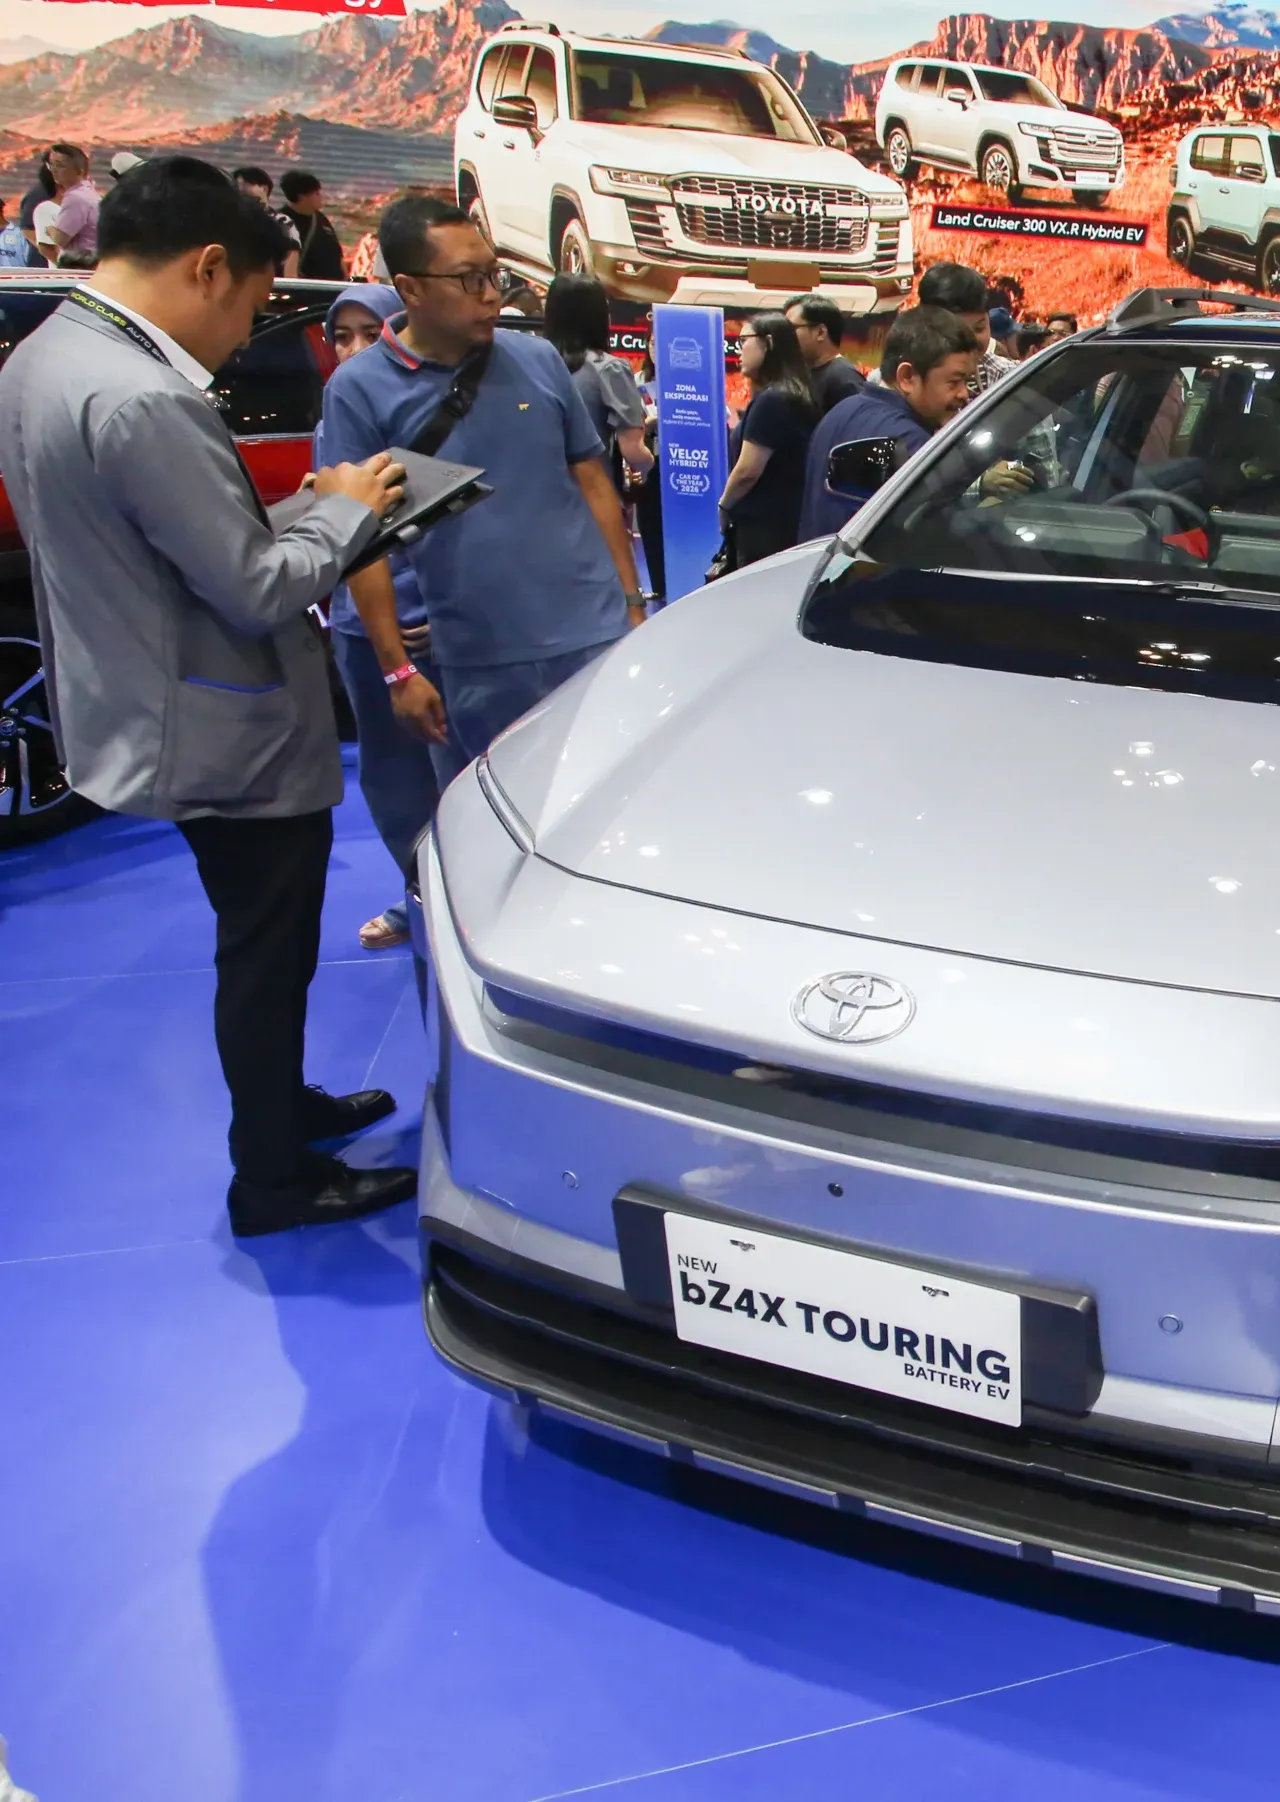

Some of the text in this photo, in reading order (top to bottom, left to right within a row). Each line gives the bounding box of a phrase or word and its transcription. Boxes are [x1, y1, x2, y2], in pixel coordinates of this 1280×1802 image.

[736, 194, 825, 217] TOYOTA
[937, 211, 1144, 241] Land Cruiser 300 VX.R Hybrid EV
[96, 305, 128, 327] CLASS
[126, 326, 152, 348] AUTO
[664, 392, 709, 402] EKSPLORASI
[675, 384, 696, 392] ZONA
[669, 448, 709, 461] VELOZ
[669, 459, 709, 469] HYBRID EV
[681, 485, 699, 493] 2026
[688, 479, 704, 487] YEAR
[677, 1253, 718, 1275] NEW
[679, 1270, 788, 1328] bZ4X
[795, 1301, 1011, 1384] TOURING
[904, 1362, 1011, 1401] BATTERY EV
